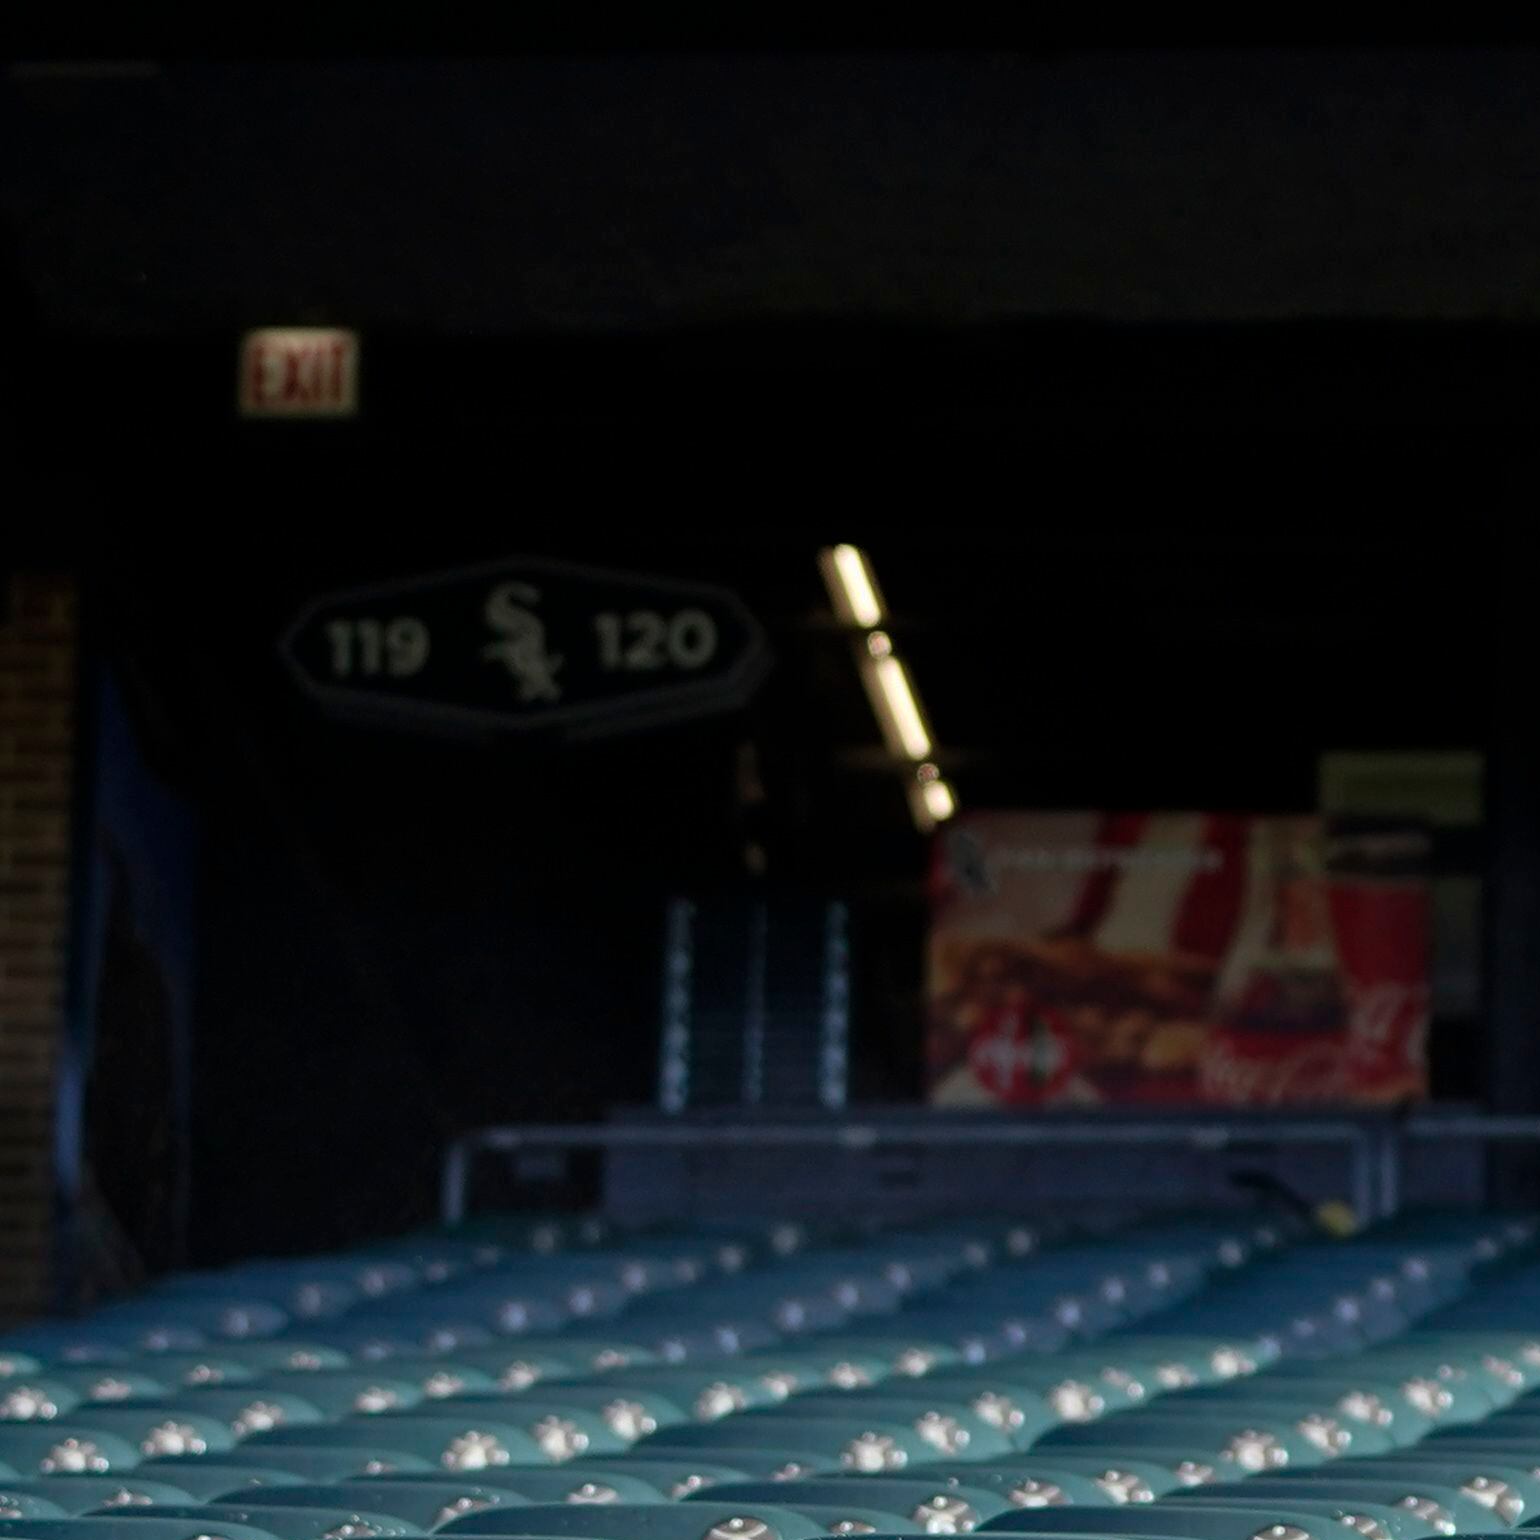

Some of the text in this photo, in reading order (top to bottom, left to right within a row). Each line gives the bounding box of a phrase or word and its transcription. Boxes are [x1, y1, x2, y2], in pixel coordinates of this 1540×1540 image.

[249, 343, 346, 404] EXIT
[323, 615, 432, 681] 119
[591, 608, 720, 673] 120
